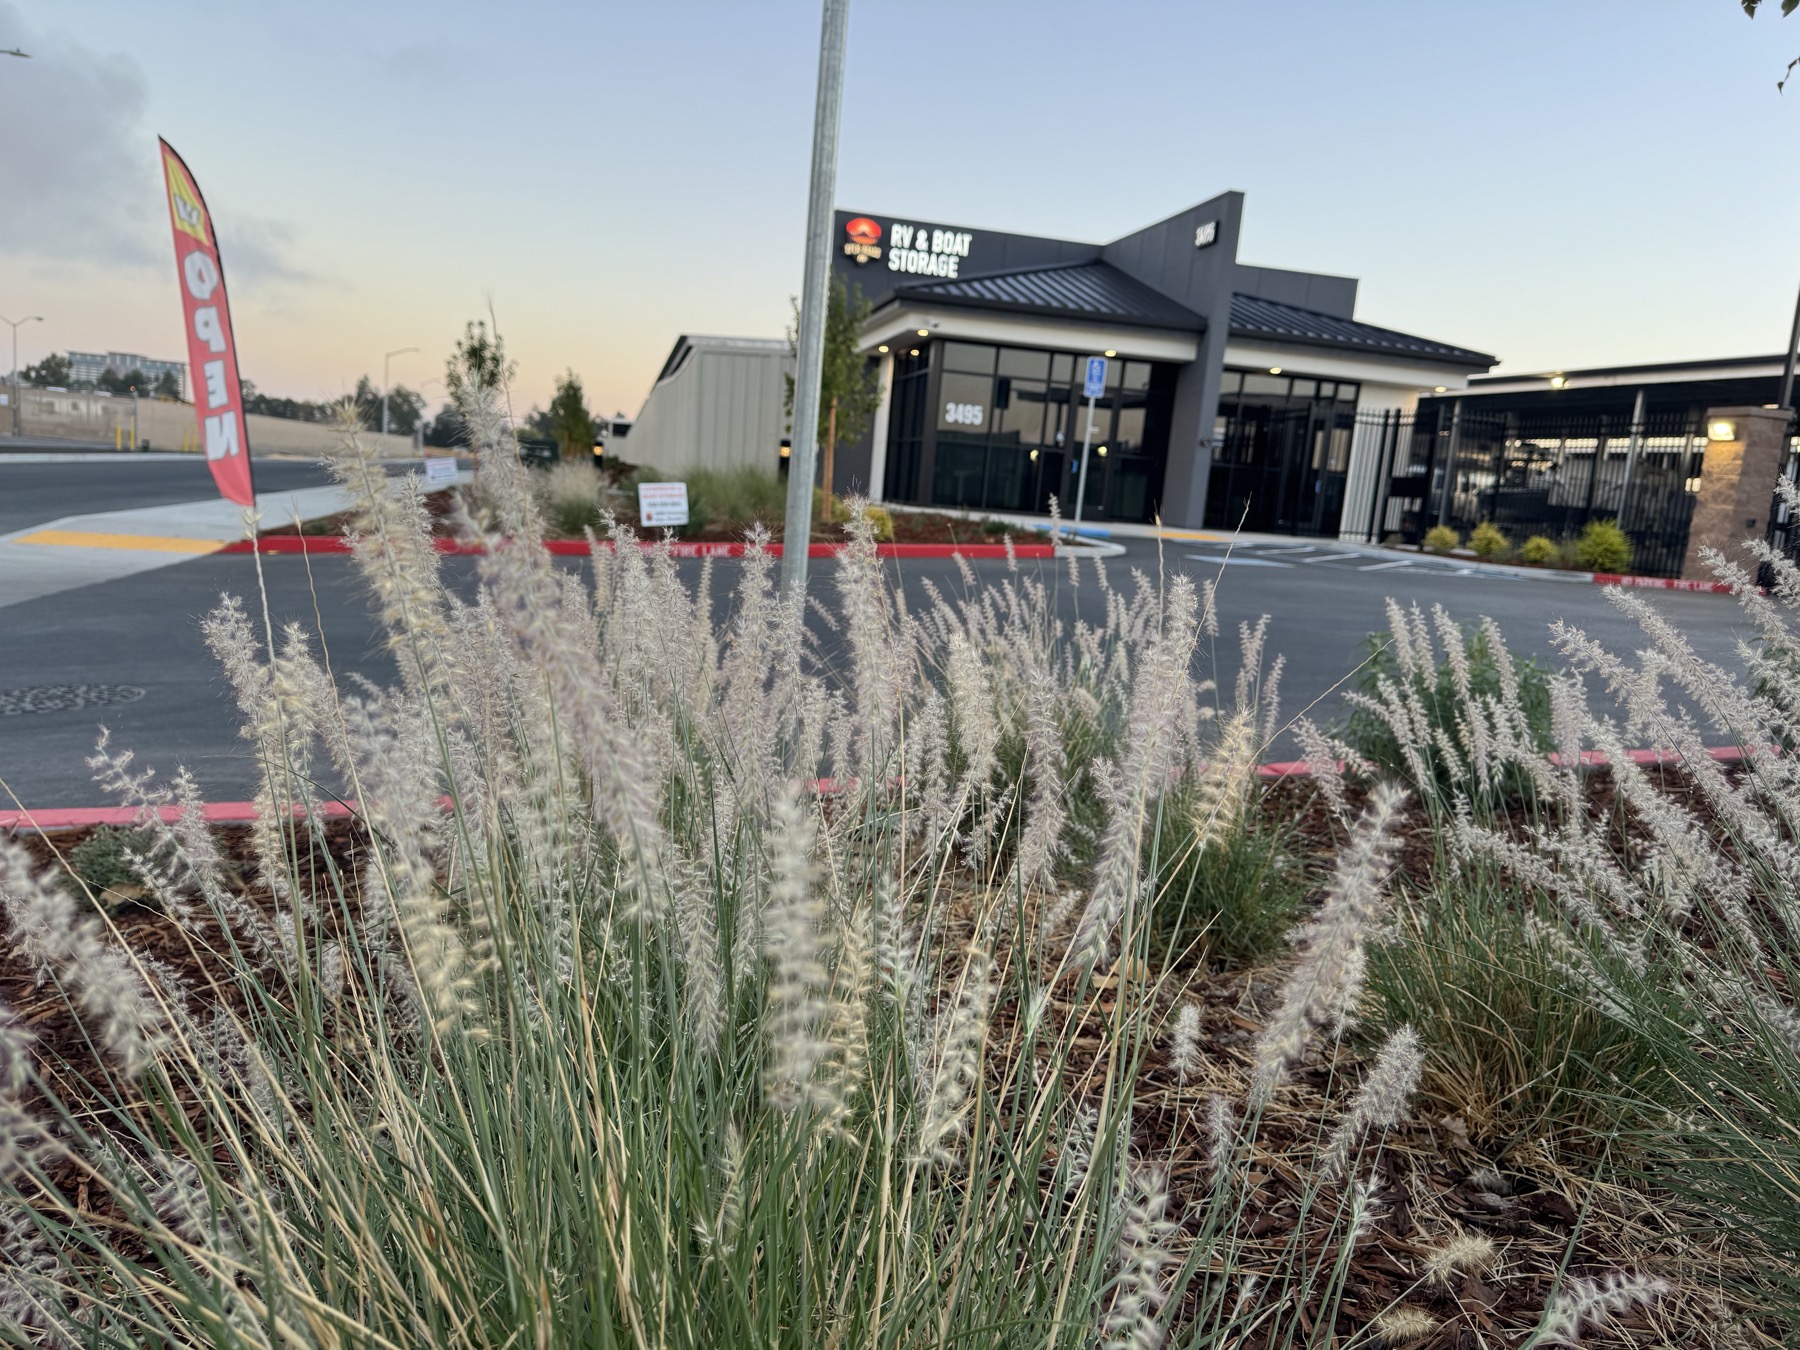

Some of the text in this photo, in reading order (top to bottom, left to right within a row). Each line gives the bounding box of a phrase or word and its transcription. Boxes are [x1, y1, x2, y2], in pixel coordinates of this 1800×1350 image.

[890, 223, 973, 257] RV & BOAT
[888, 247, 960, 279] STORAGE
[945, 402, 983, 426] 3495
[673, 544, 698, 557] FIRE
[702, 545, 730, 557] LANE
[1673, 581, 1692, 591] FIRE
